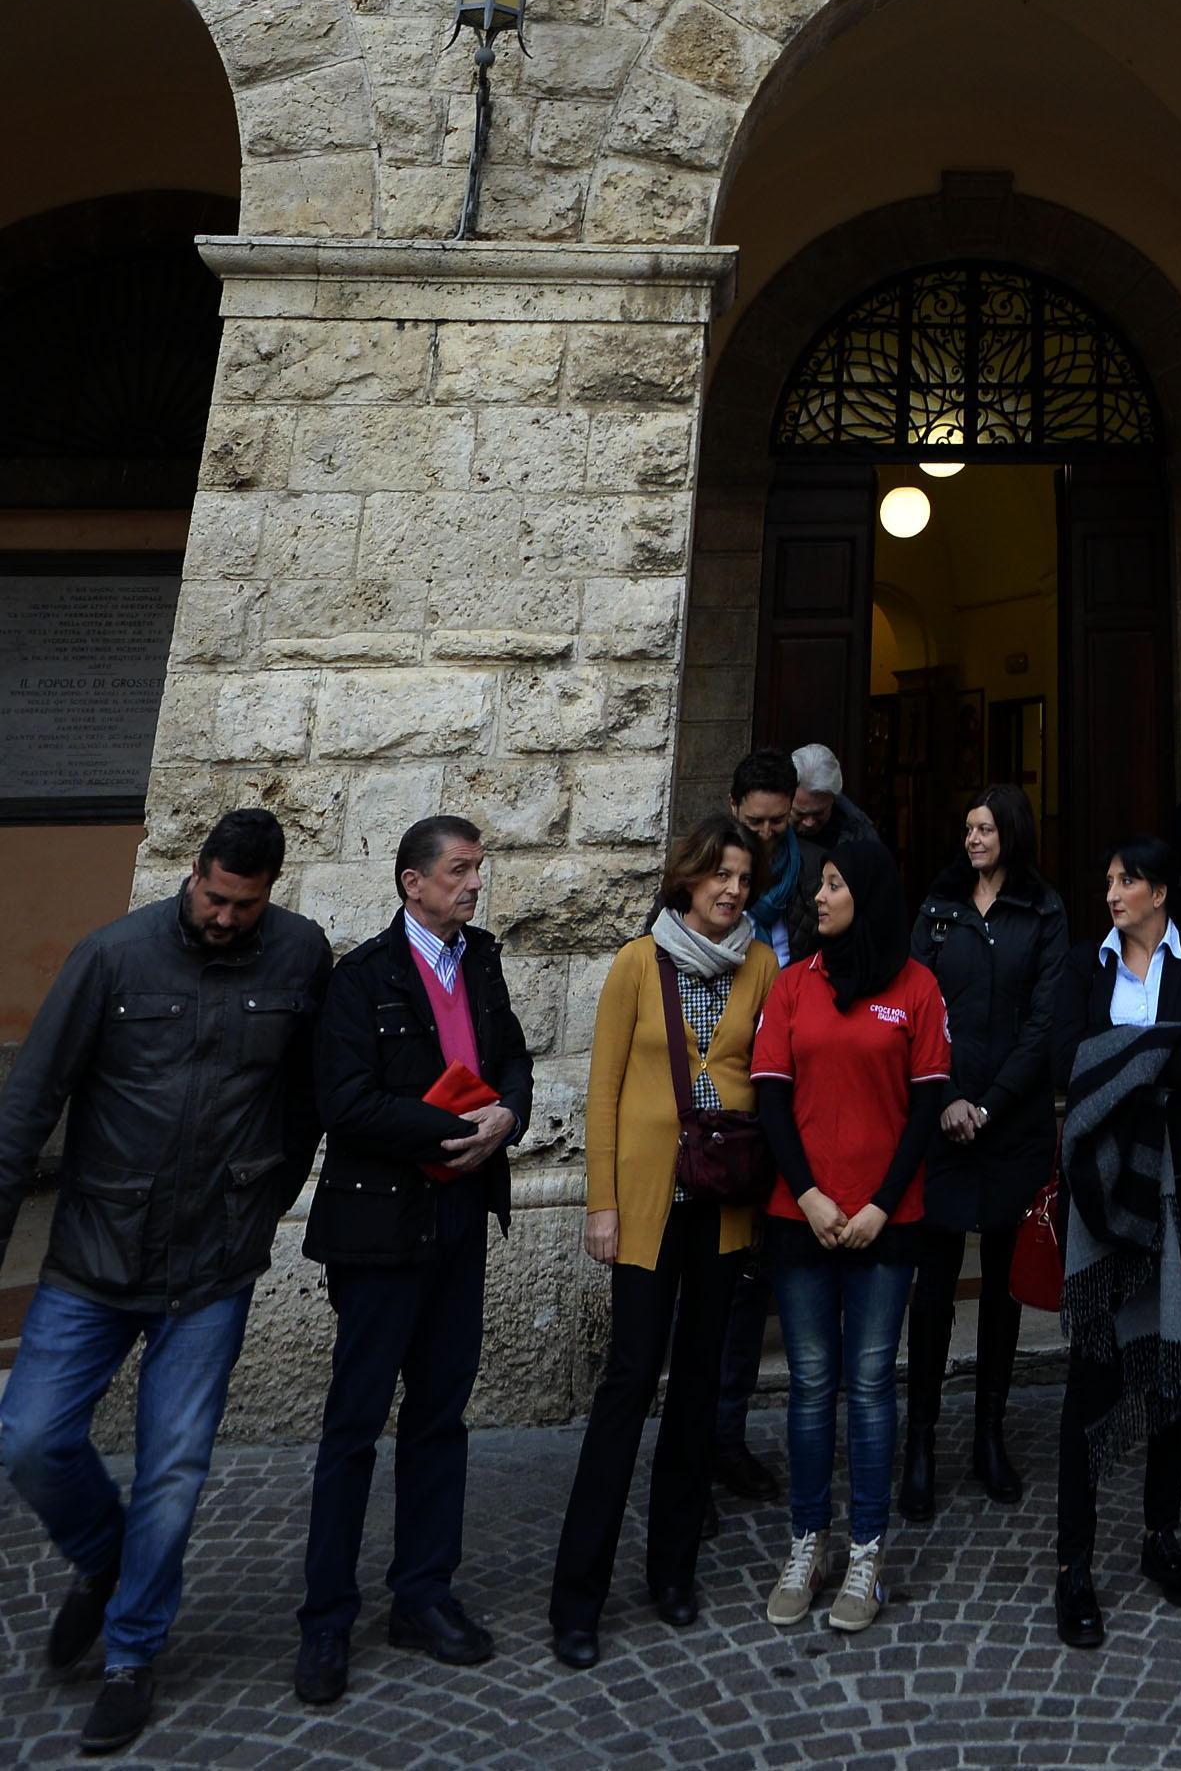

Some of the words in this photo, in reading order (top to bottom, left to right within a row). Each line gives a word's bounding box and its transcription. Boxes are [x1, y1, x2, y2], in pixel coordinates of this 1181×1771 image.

[19, 678, 29, 689] IL
[37, 677, 87, 689] POPOLO
[92, 677, 105, 689] DI
[111, 677, 162, 689] GROSSET
